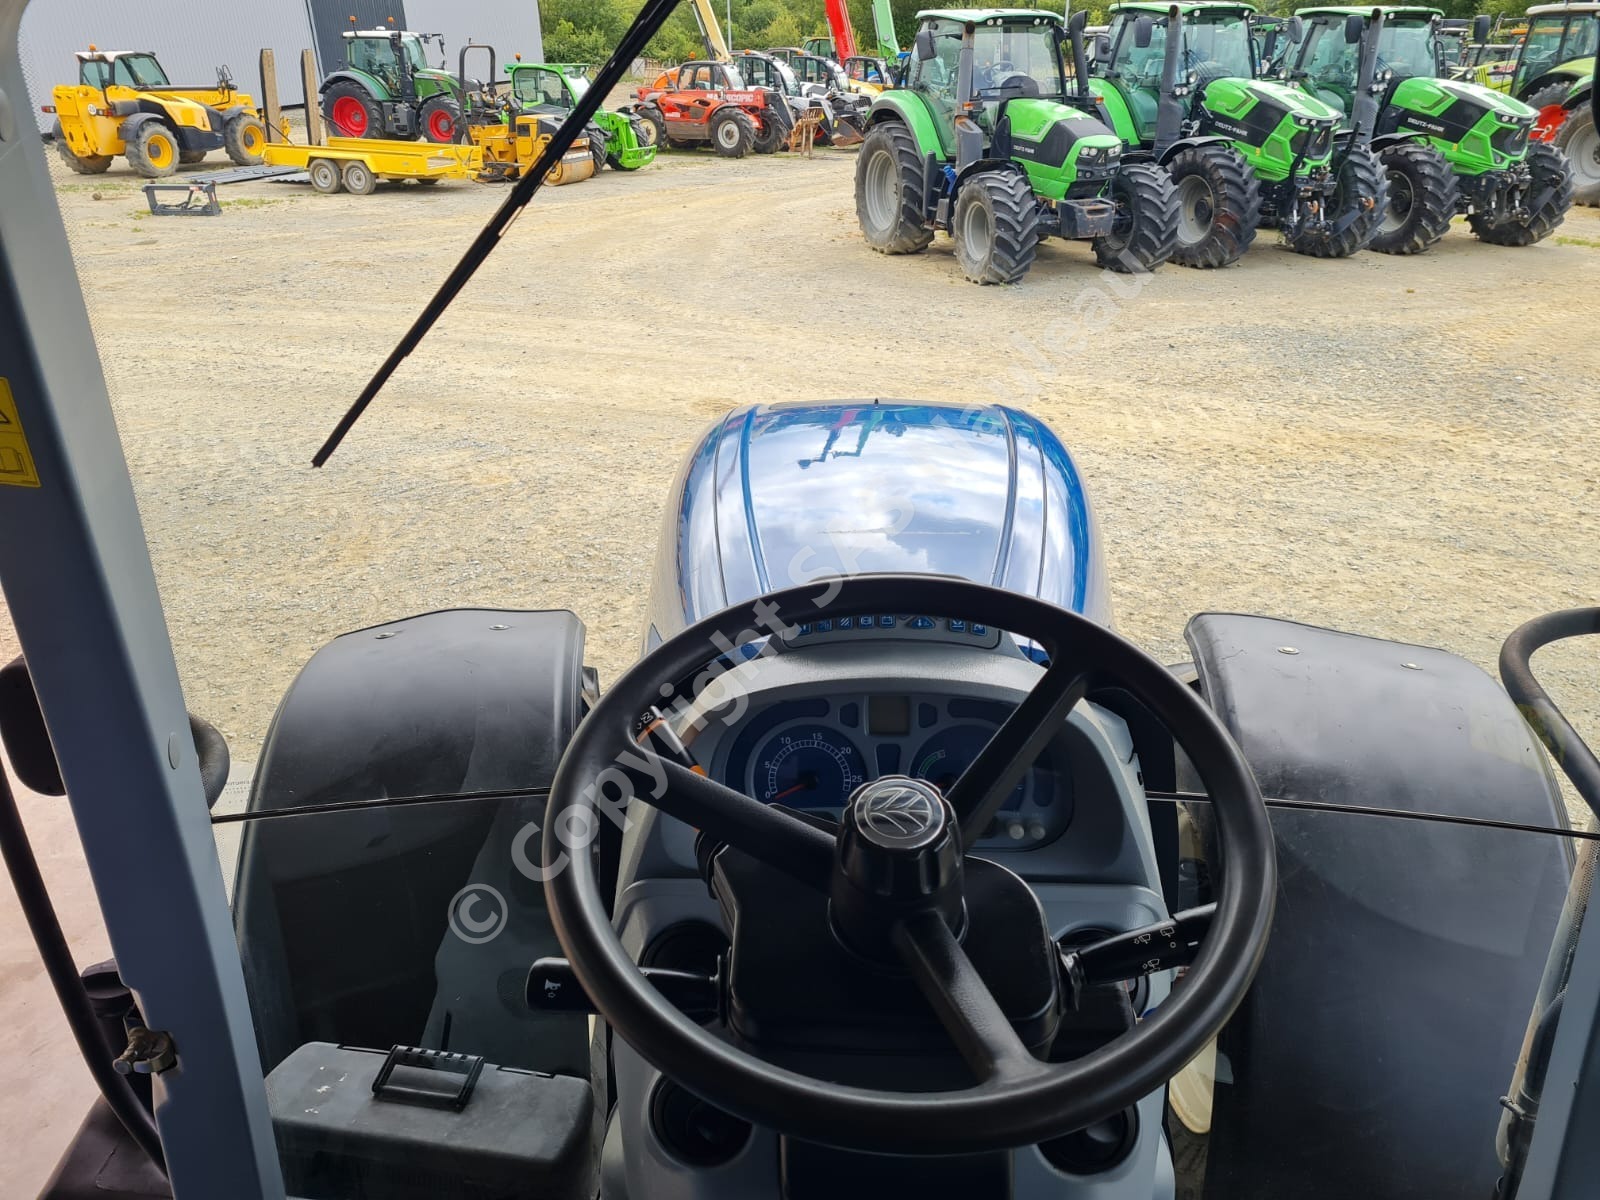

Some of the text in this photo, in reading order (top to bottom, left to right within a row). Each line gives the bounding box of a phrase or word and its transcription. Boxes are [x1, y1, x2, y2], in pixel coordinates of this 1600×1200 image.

[780, 736, 791, 745] 10
[812, 732, 823, 741] 15
[840, 747, 852, 755] 20
[764, 761, 770, 769] 5
[851, 775, 863, 783] 25
[764, 791, 771, 799] 0
